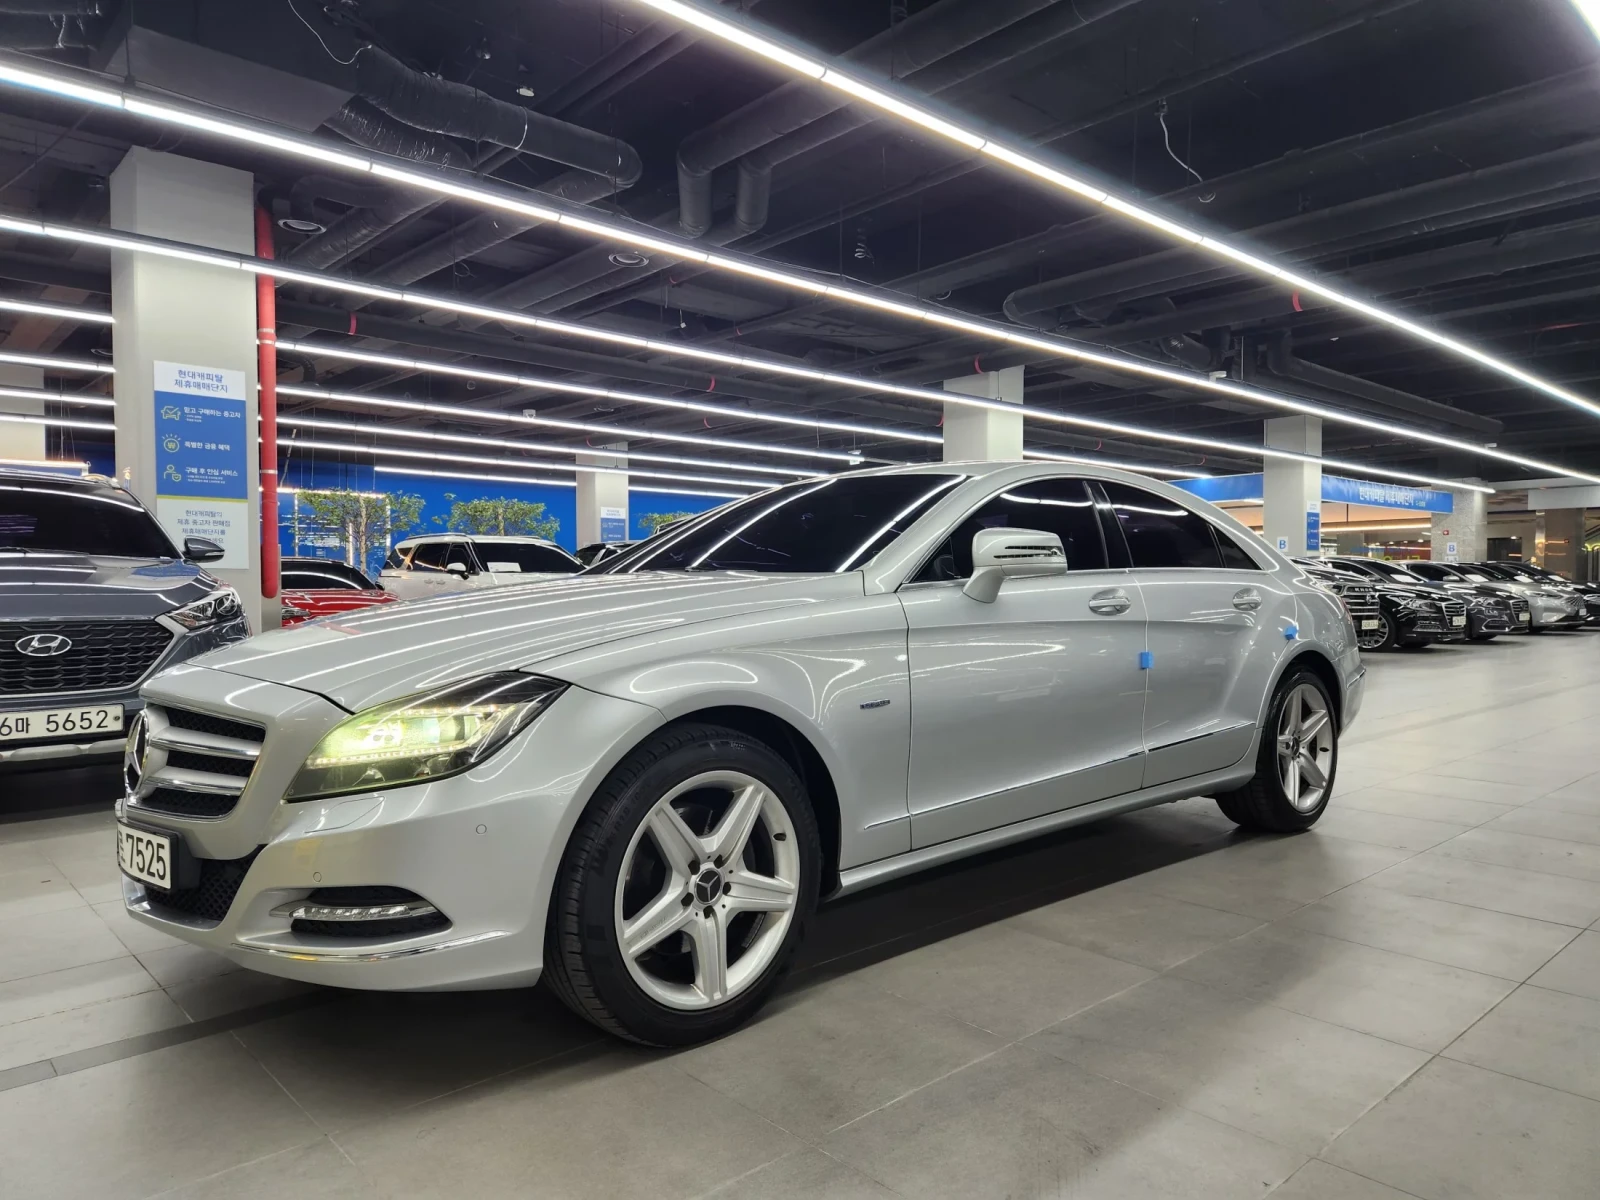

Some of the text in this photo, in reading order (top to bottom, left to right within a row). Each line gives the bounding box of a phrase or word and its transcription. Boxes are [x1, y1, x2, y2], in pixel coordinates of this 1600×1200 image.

[178, 369, 223, 383] 현대캐피탈
[174, 379, 228, 393] 제휴매매단지
[198, 408, 222, 416] 구매하는
[223, 410, 241, 419] 중고차
[220, 469, 239, 477] 서비스
[1279, 539, 1287, 550] B
[45, 709, 109, 733] 5652
[125, 832, 166, 881] 7525
